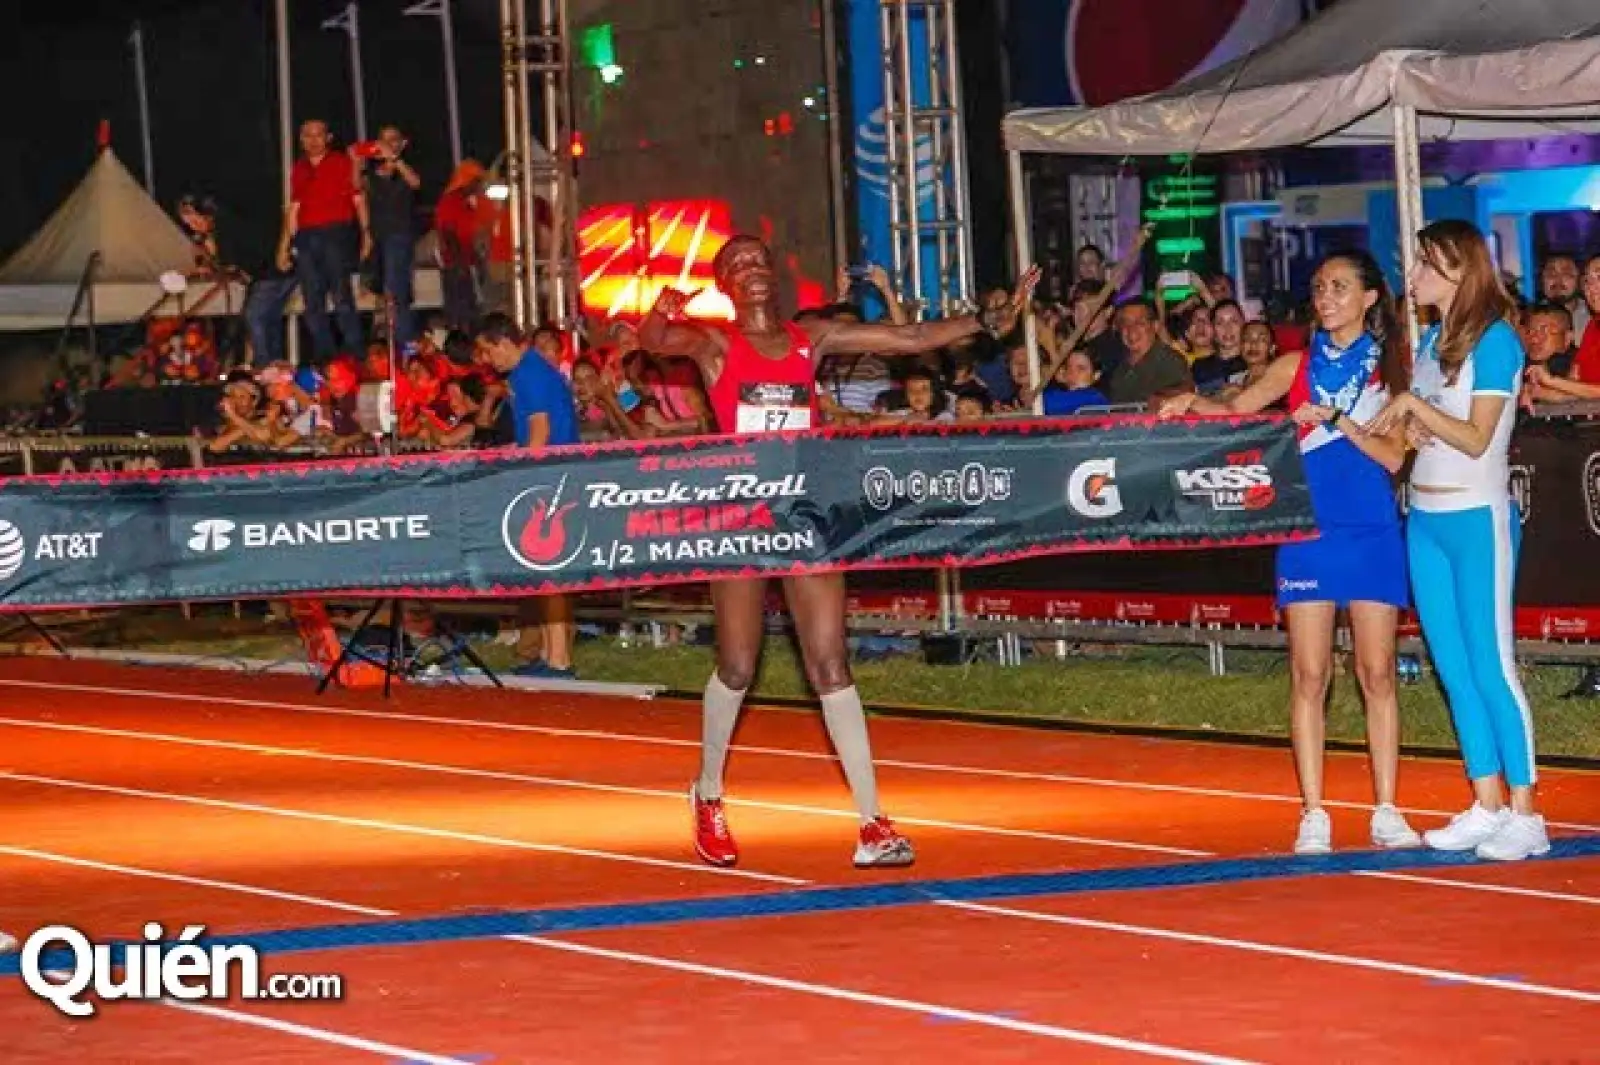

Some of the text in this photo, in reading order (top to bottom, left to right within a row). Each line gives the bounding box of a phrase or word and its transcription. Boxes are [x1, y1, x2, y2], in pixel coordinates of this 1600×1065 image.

[764, 409, 790, 433] F7
[1067, 457, 1123, 518] G
[1174, 464, 1271, 489] KISS
[243, 514, 431, 546] BANORTE
[34, 532, 102, 560] AT&T
[590, 529, 814, 570] 1/2 MARATHON
